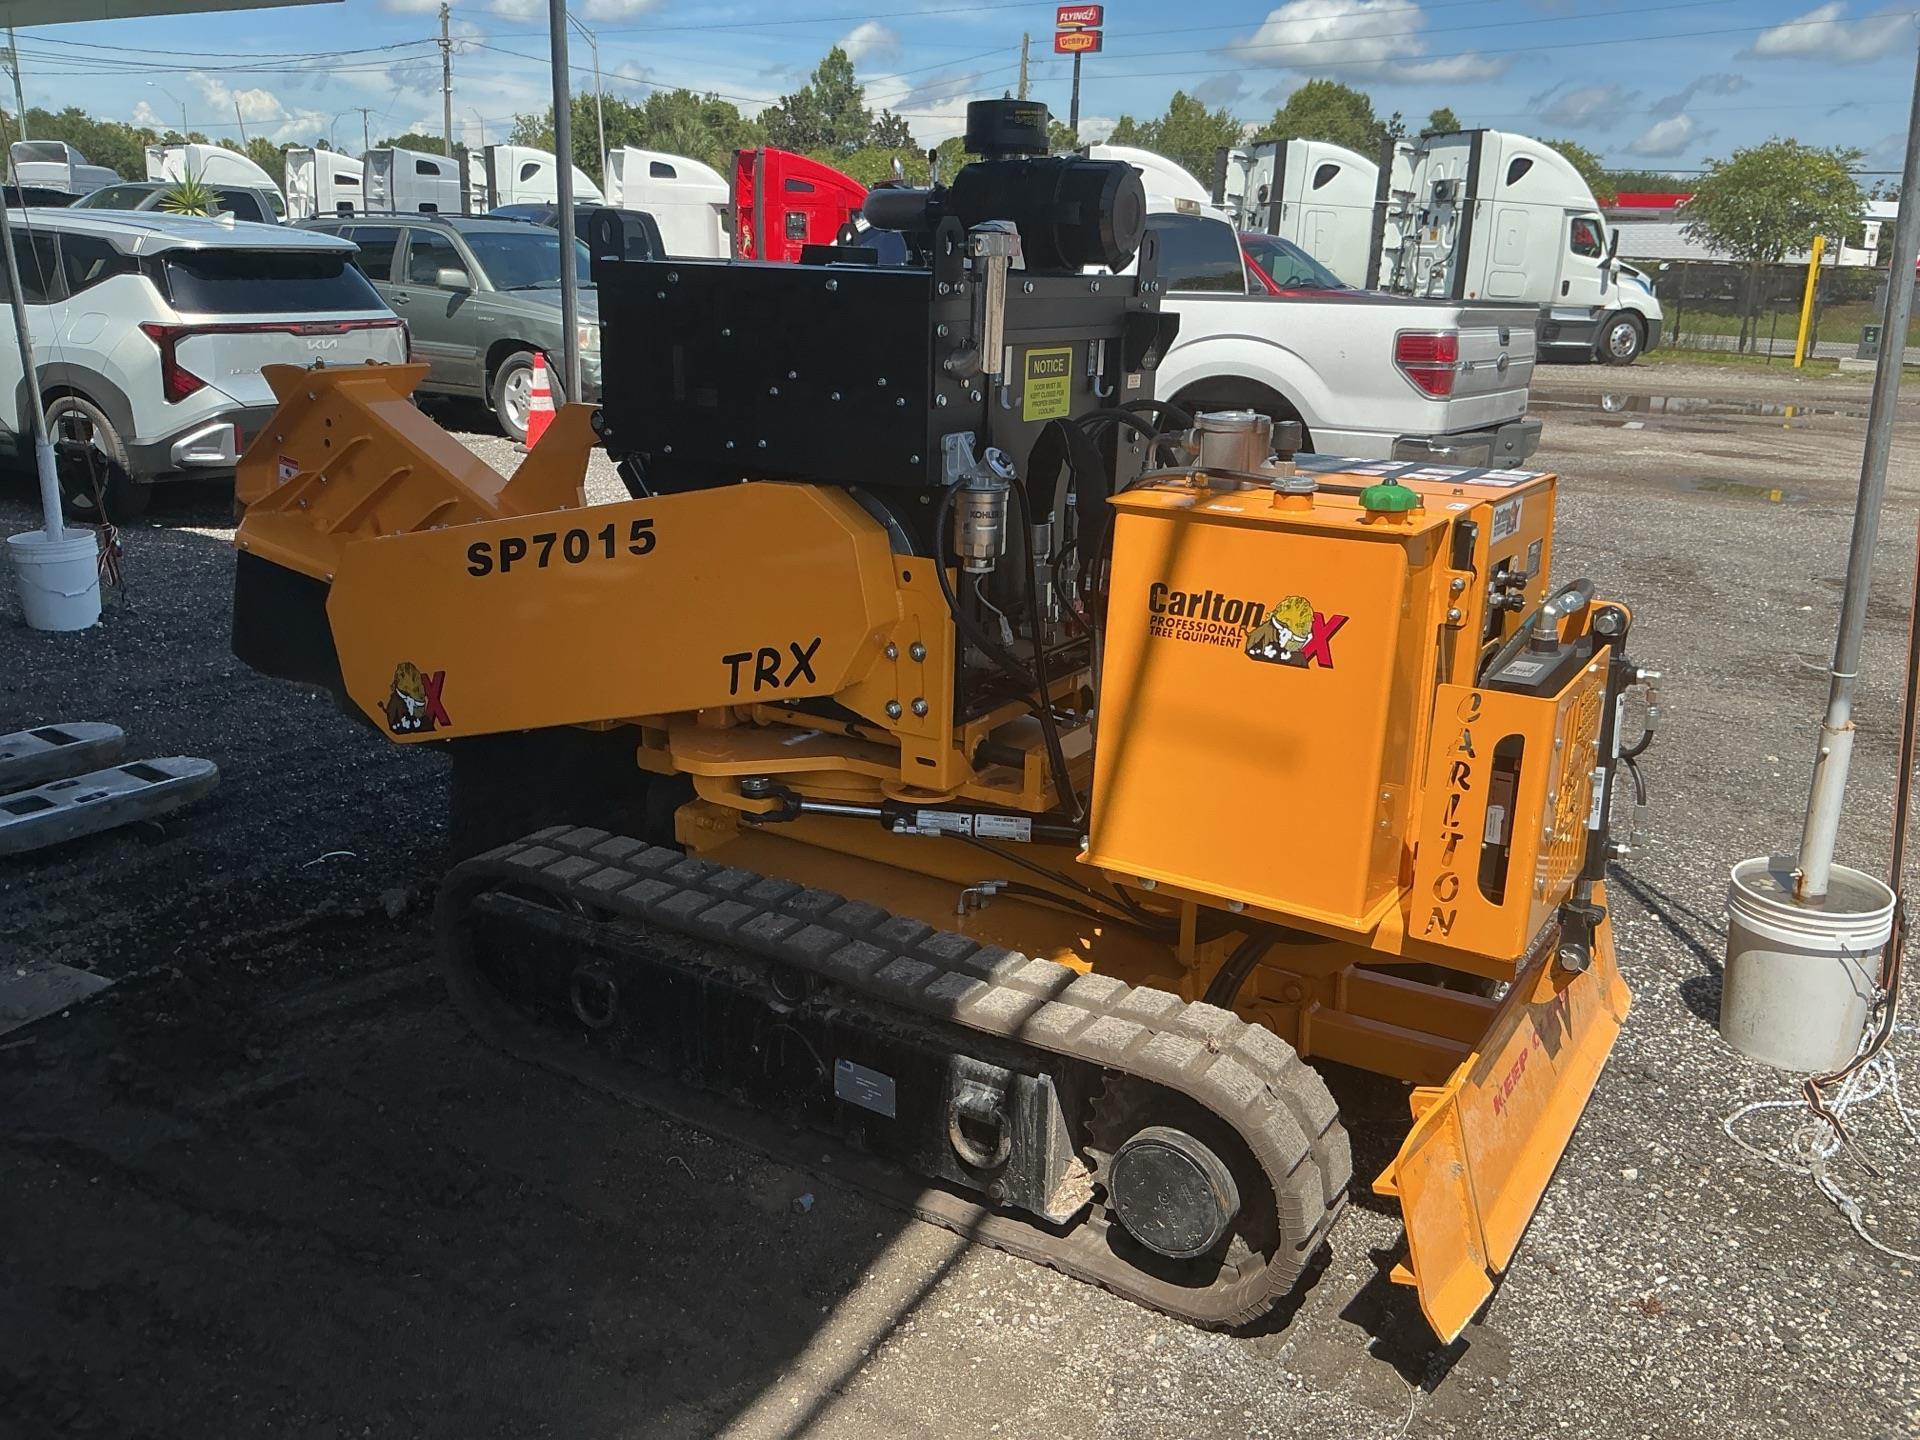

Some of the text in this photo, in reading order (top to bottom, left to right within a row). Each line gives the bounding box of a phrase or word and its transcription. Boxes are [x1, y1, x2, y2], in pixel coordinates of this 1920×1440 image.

[1060, 10, 1088, 21] FLYING
[1061, 37, 1091, 46] Denny's
[1033, 358, 1065, 374] NOTICE
[1041, 390, 1056, 398] CLOSED
[970, 511, 1001, 519] KOHLER
[467, 518, 656, 577] SP7015
[1149, 582, 1265, 629] Carlton
[1150, 615, 1243, 638] PROFESSIONAL
[1150, 625, 1242, 648] TREE EQUIPMENT
[722, 637, 822, 695] TRX
[1424, 692, 1482, 937] CARLTON
[1493, 1047, 1528, 1116] KEEP
